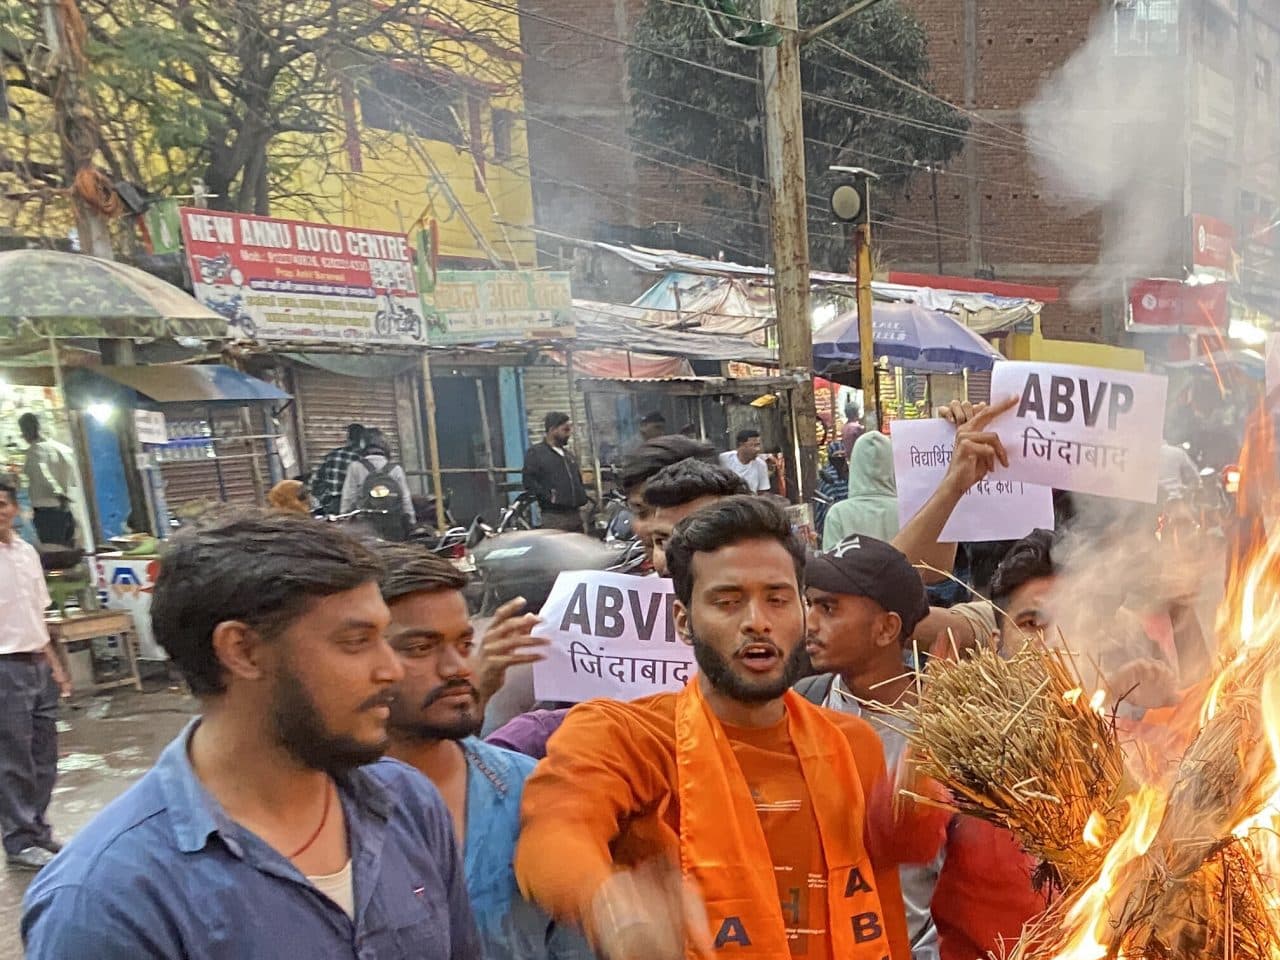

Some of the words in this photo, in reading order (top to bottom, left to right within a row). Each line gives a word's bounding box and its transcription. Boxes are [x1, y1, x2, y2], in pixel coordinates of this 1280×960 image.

[187, 213, 236, 244] NEW
[294, 225, 343, 254] AUTO
[345, 231, 409, 261] CENTRE
[1016, 373, 1134, 431] ABVP
[1021, 427, 1128, 472] जिंदाबाद
[568, 641, 692, 686] जिंदाबाद
